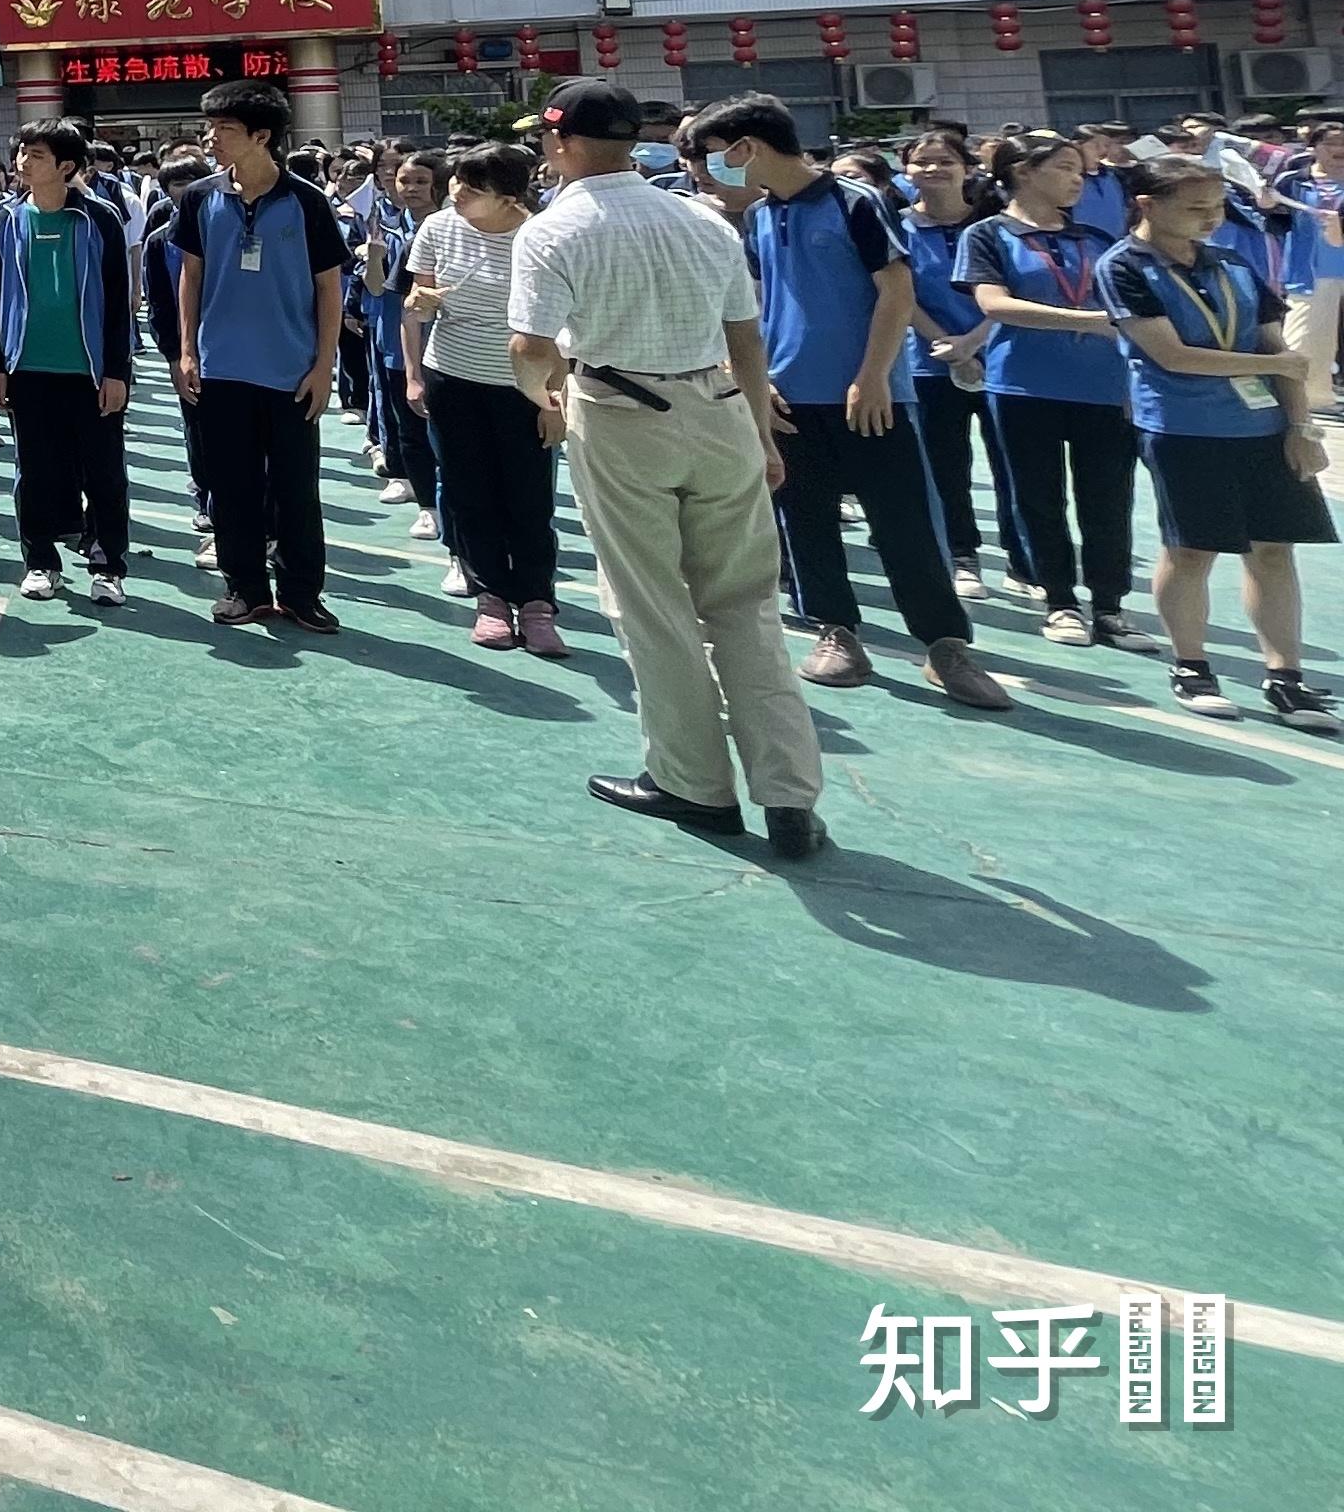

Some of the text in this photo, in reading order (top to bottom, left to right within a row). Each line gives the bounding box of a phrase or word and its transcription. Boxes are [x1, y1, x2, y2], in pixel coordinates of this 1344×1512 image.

[63, 51, 288, 84] 生紧急疏散、防
